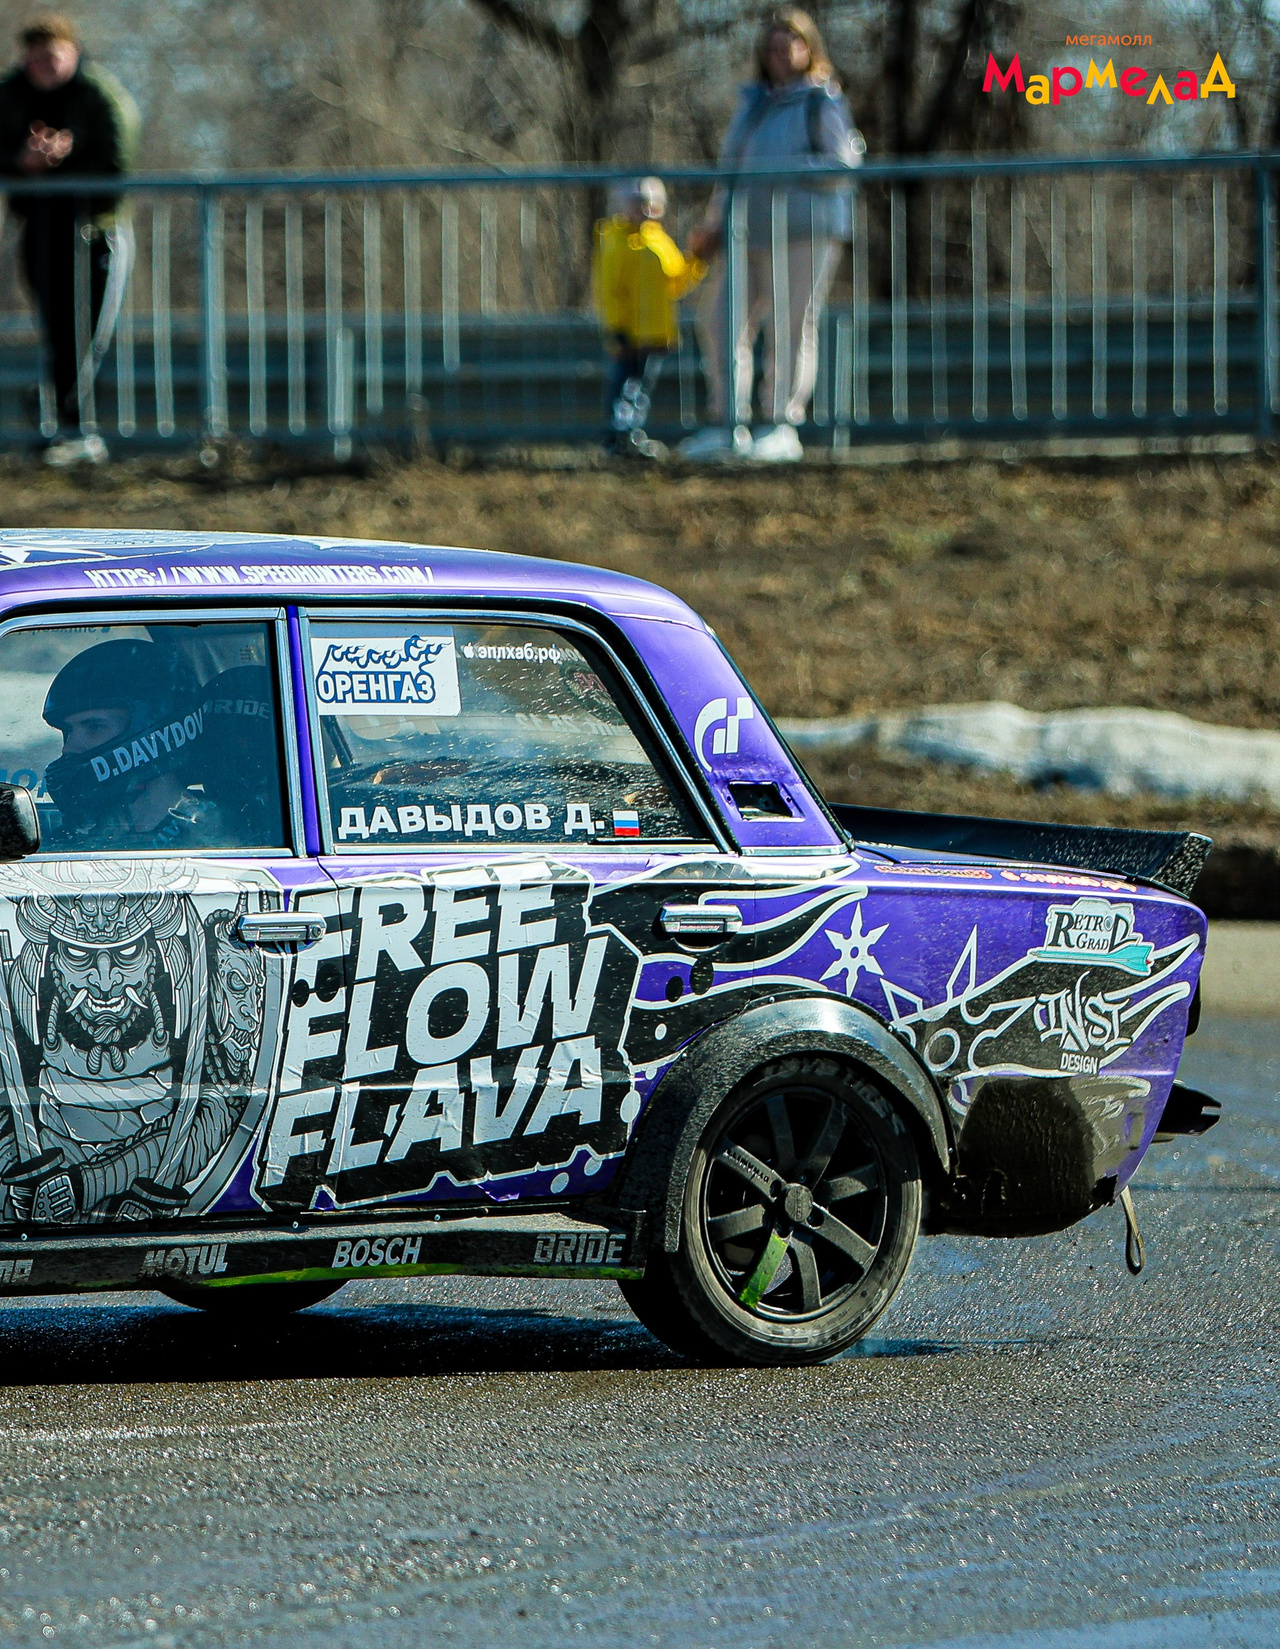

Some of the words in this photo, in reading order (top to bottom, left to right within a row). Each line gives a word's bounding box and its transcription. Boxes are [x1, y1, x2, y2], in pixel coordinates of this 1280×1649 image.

[478, 643, 561, 664] эплхаб.рф
[317, 673, 435, 702] ОРЕНГАЗ
[338, 804, 552, 839] ДАВЫДОВ
[564, 803, 604, 836] Д.
[295, 861, 558, 990] FREE
[279, 936, 608, 1092] FLOW
[1060, 1053, 1100, 1075] DESIGN
[260, 1035, 602, 1188] FLAVA
[140, 1243, 229, 1275] MOTUL
[331, 1236, 423, 1268] BOSCH
[533, 1233, 626, 1264] BRIDE
